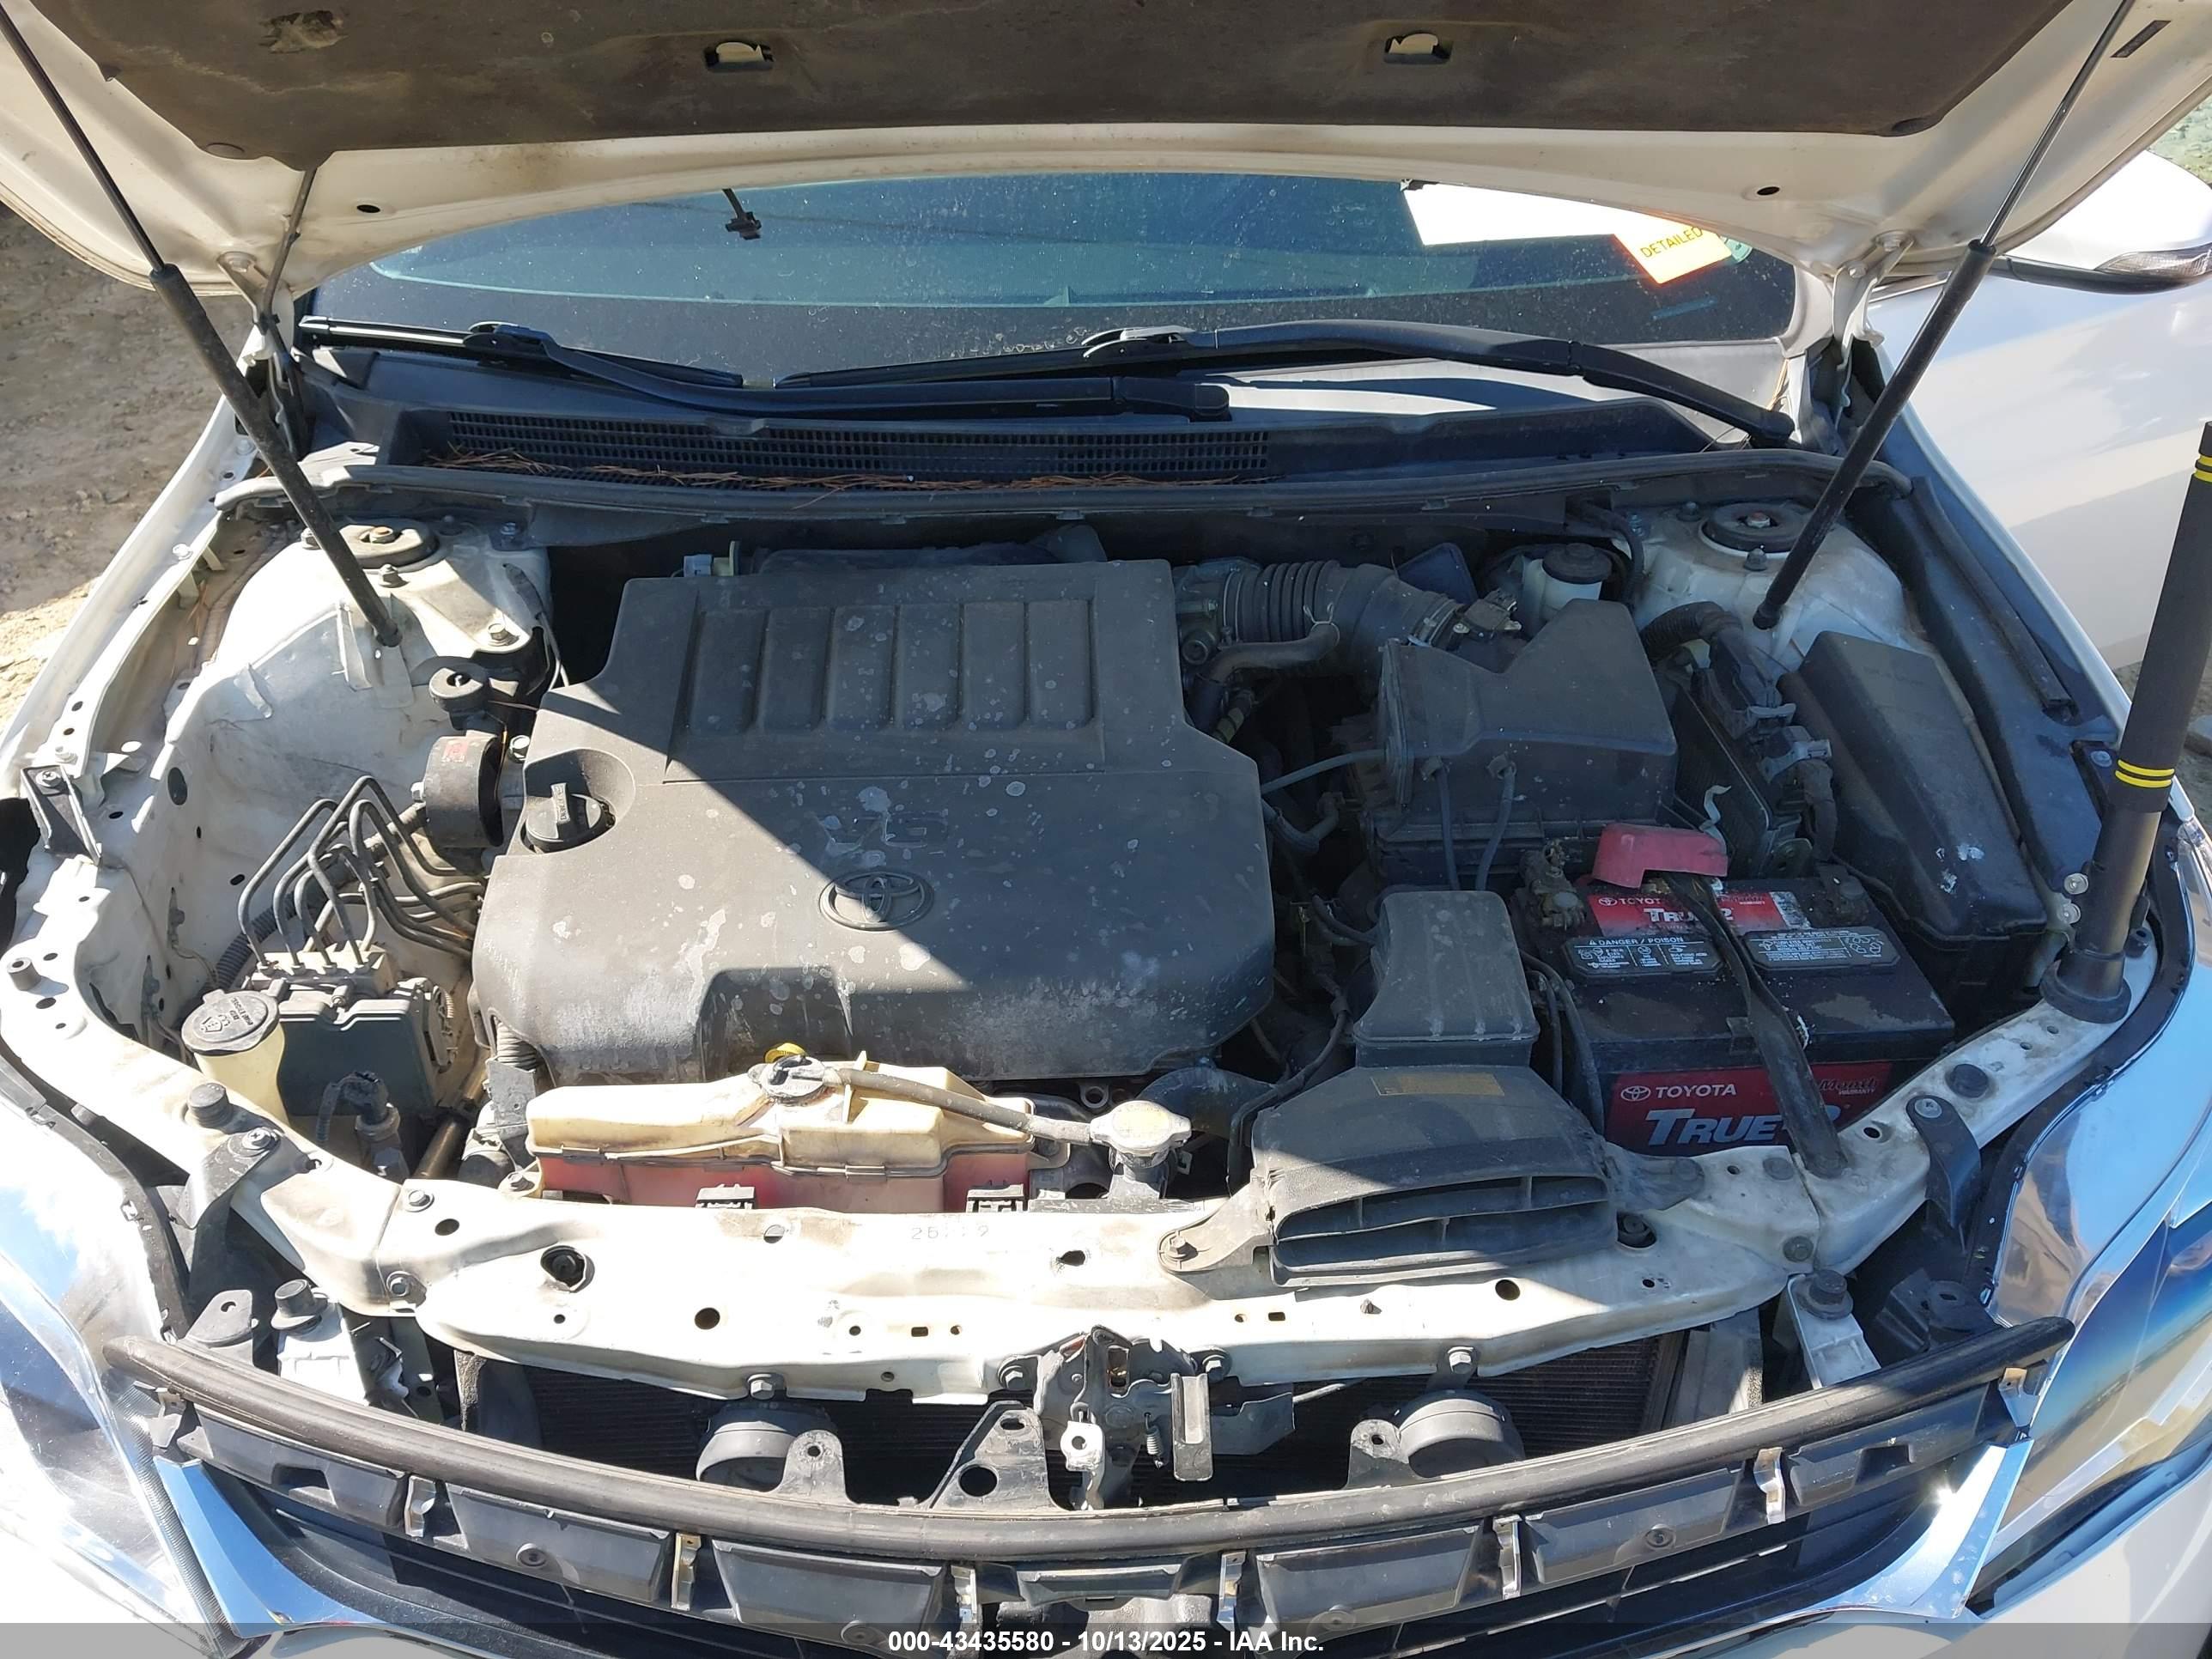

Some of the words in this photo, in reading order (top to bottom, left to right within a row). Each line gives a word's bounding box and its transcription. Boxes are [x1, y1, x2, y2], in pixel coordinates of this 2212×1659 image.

[1639, 226, 1704, 258] DETAILED
[1656, 1084, 1737, 1098] TOYOTA
[1646, 1105, 1841, 1146] TRUE
